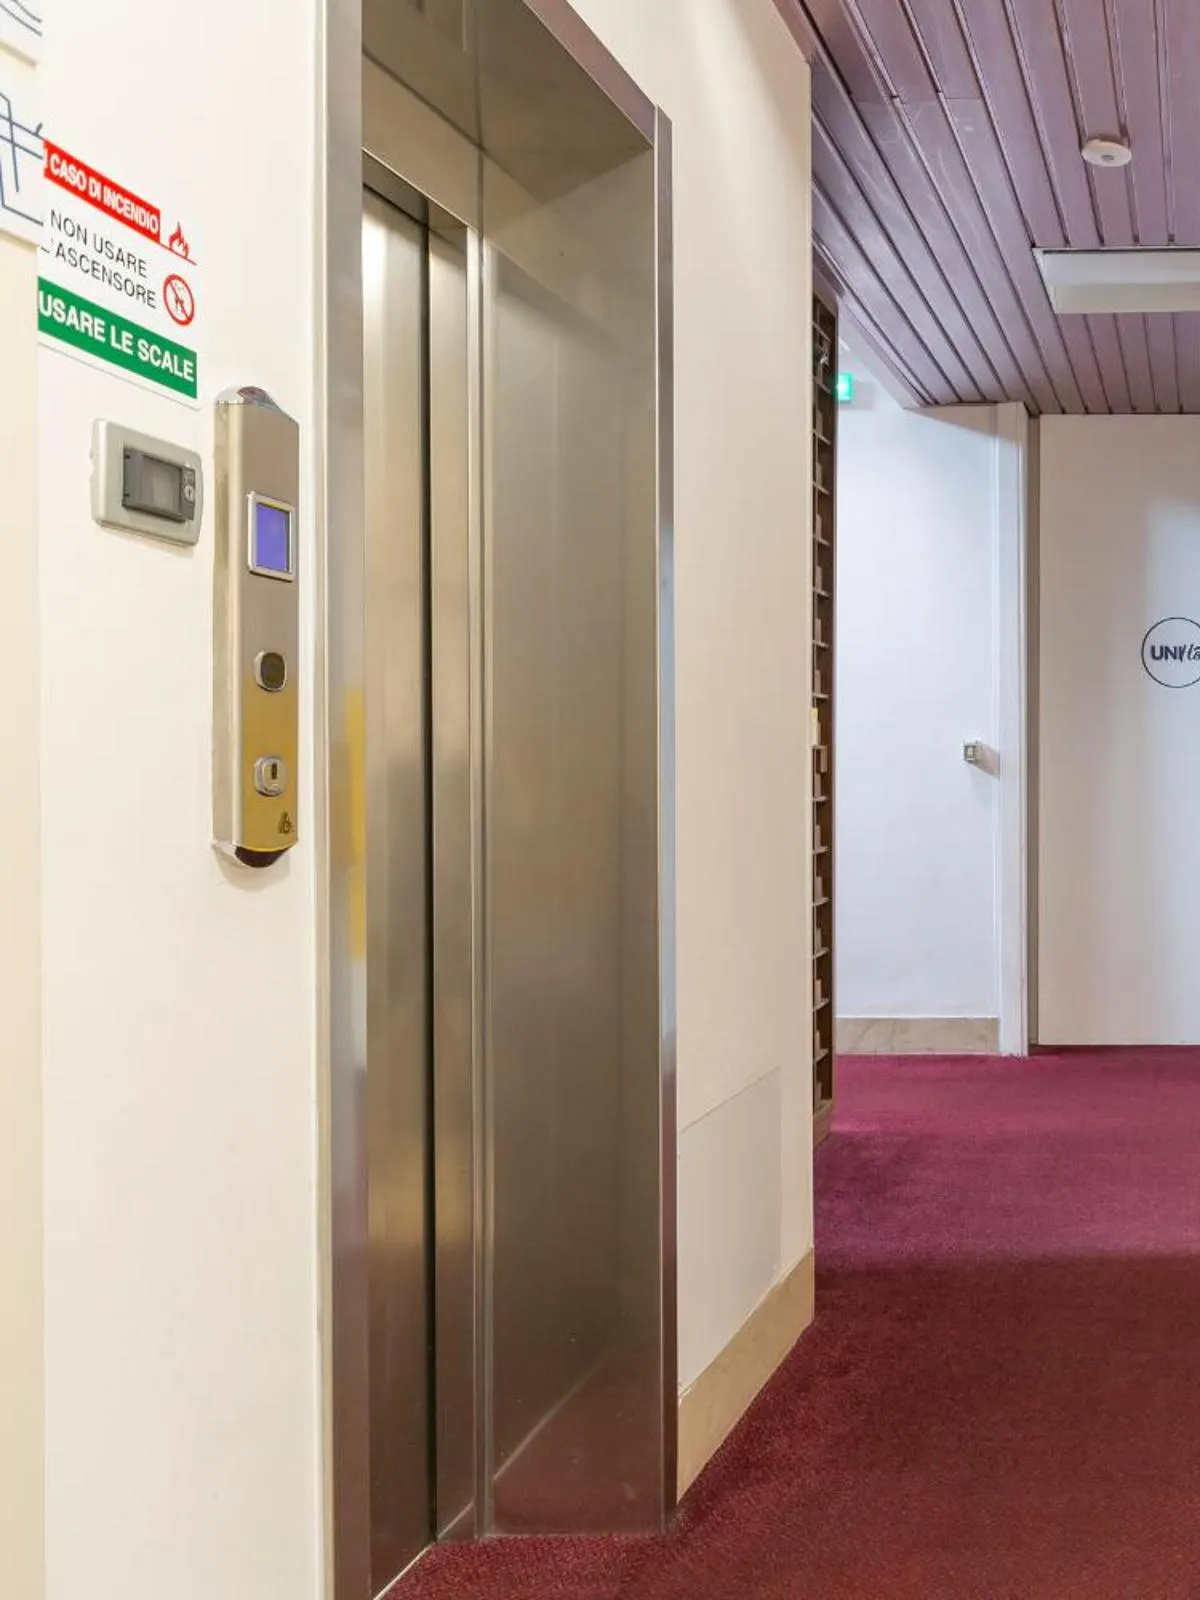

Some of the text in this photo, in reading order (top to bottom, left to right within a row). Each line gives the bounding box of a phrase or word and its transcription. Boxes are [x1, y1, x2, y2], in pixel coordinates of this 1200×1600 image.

[50, 153, 86, 191] CASO
[89, 177, 101, 201] DI
[103, 184, 159, 234] INCENDIO
[41, 239, 157, 310] 'ASCENSORE
[51, 208, 148, 279] NON USARE
[38, 290, 195, 383] USARE LE SCALE
